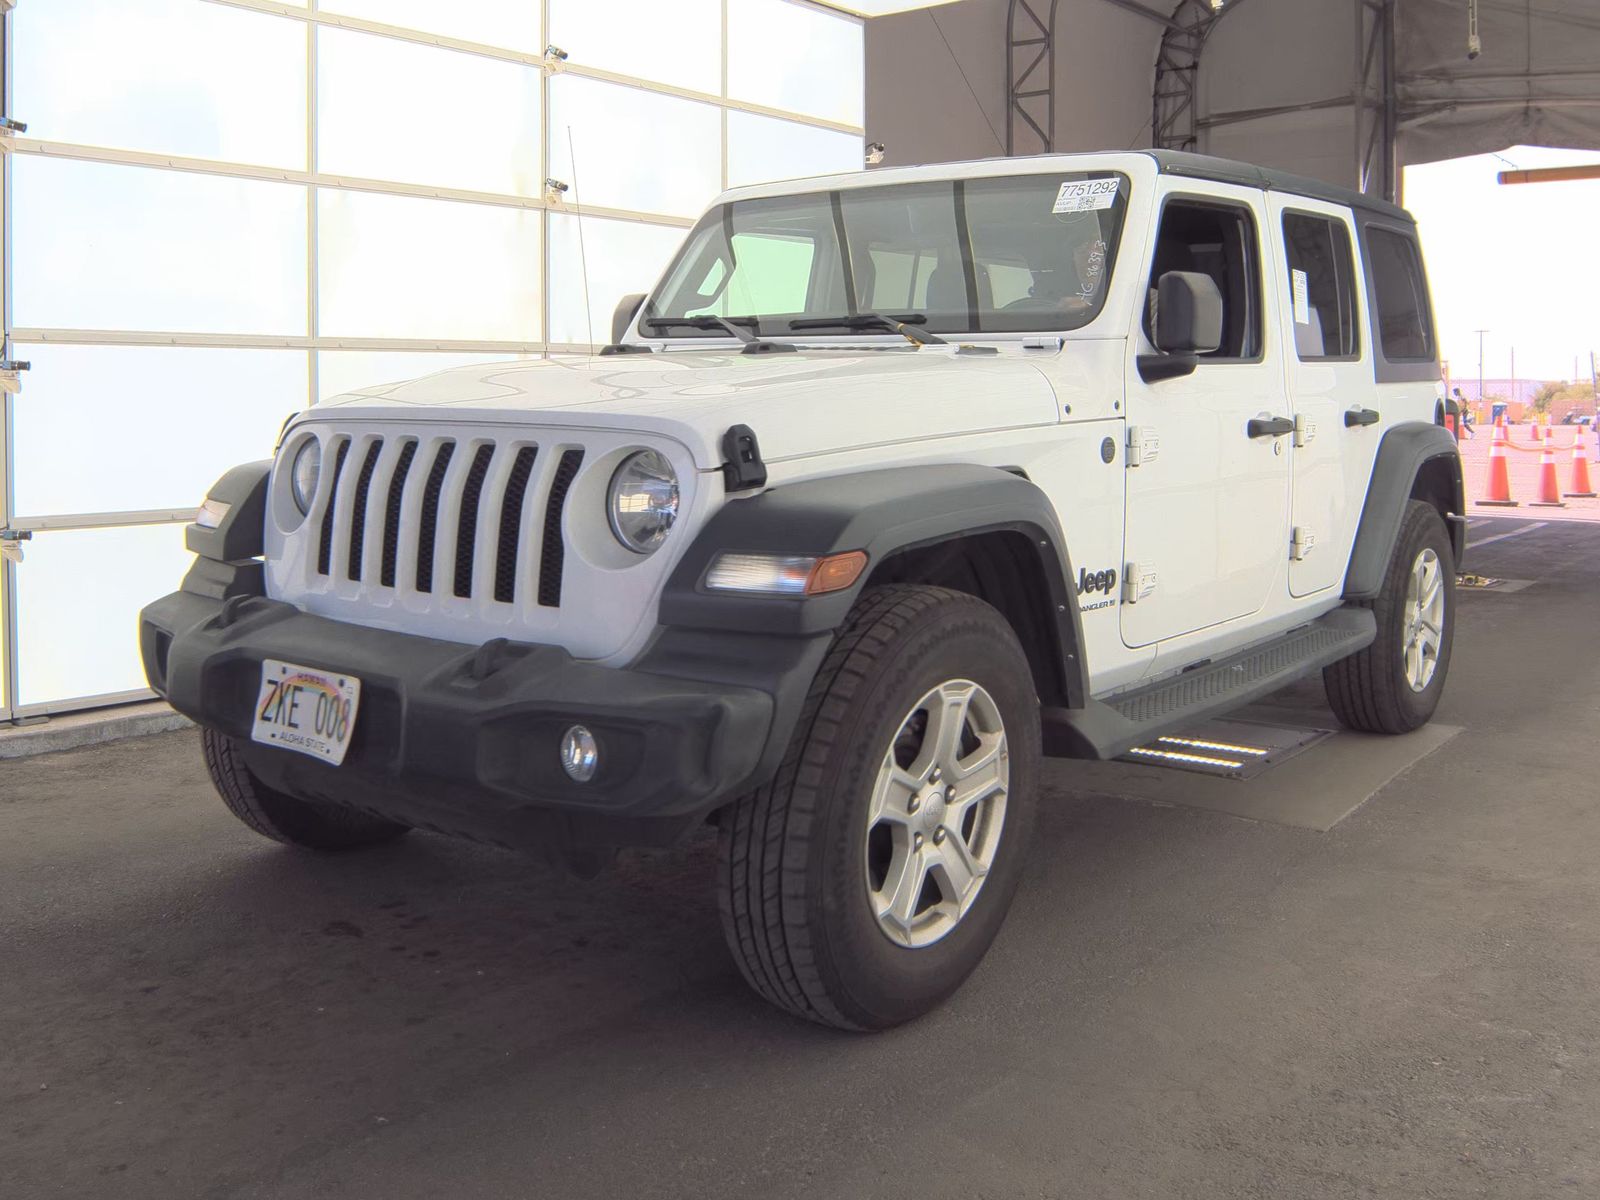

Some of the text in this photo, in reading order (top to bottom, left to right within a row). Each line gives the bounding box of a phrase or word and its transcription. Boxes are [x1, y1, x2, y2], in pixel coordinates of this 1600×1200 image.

[1061, 181, 1118, 198] 7751292
[1074, 567, 1117, 596] Jeep
[1080, 600, 1108, 612] ANGLER
[260, 679, 352, 743] ZKE 008
[279, 730, 326, 753] ALOHA STATE
